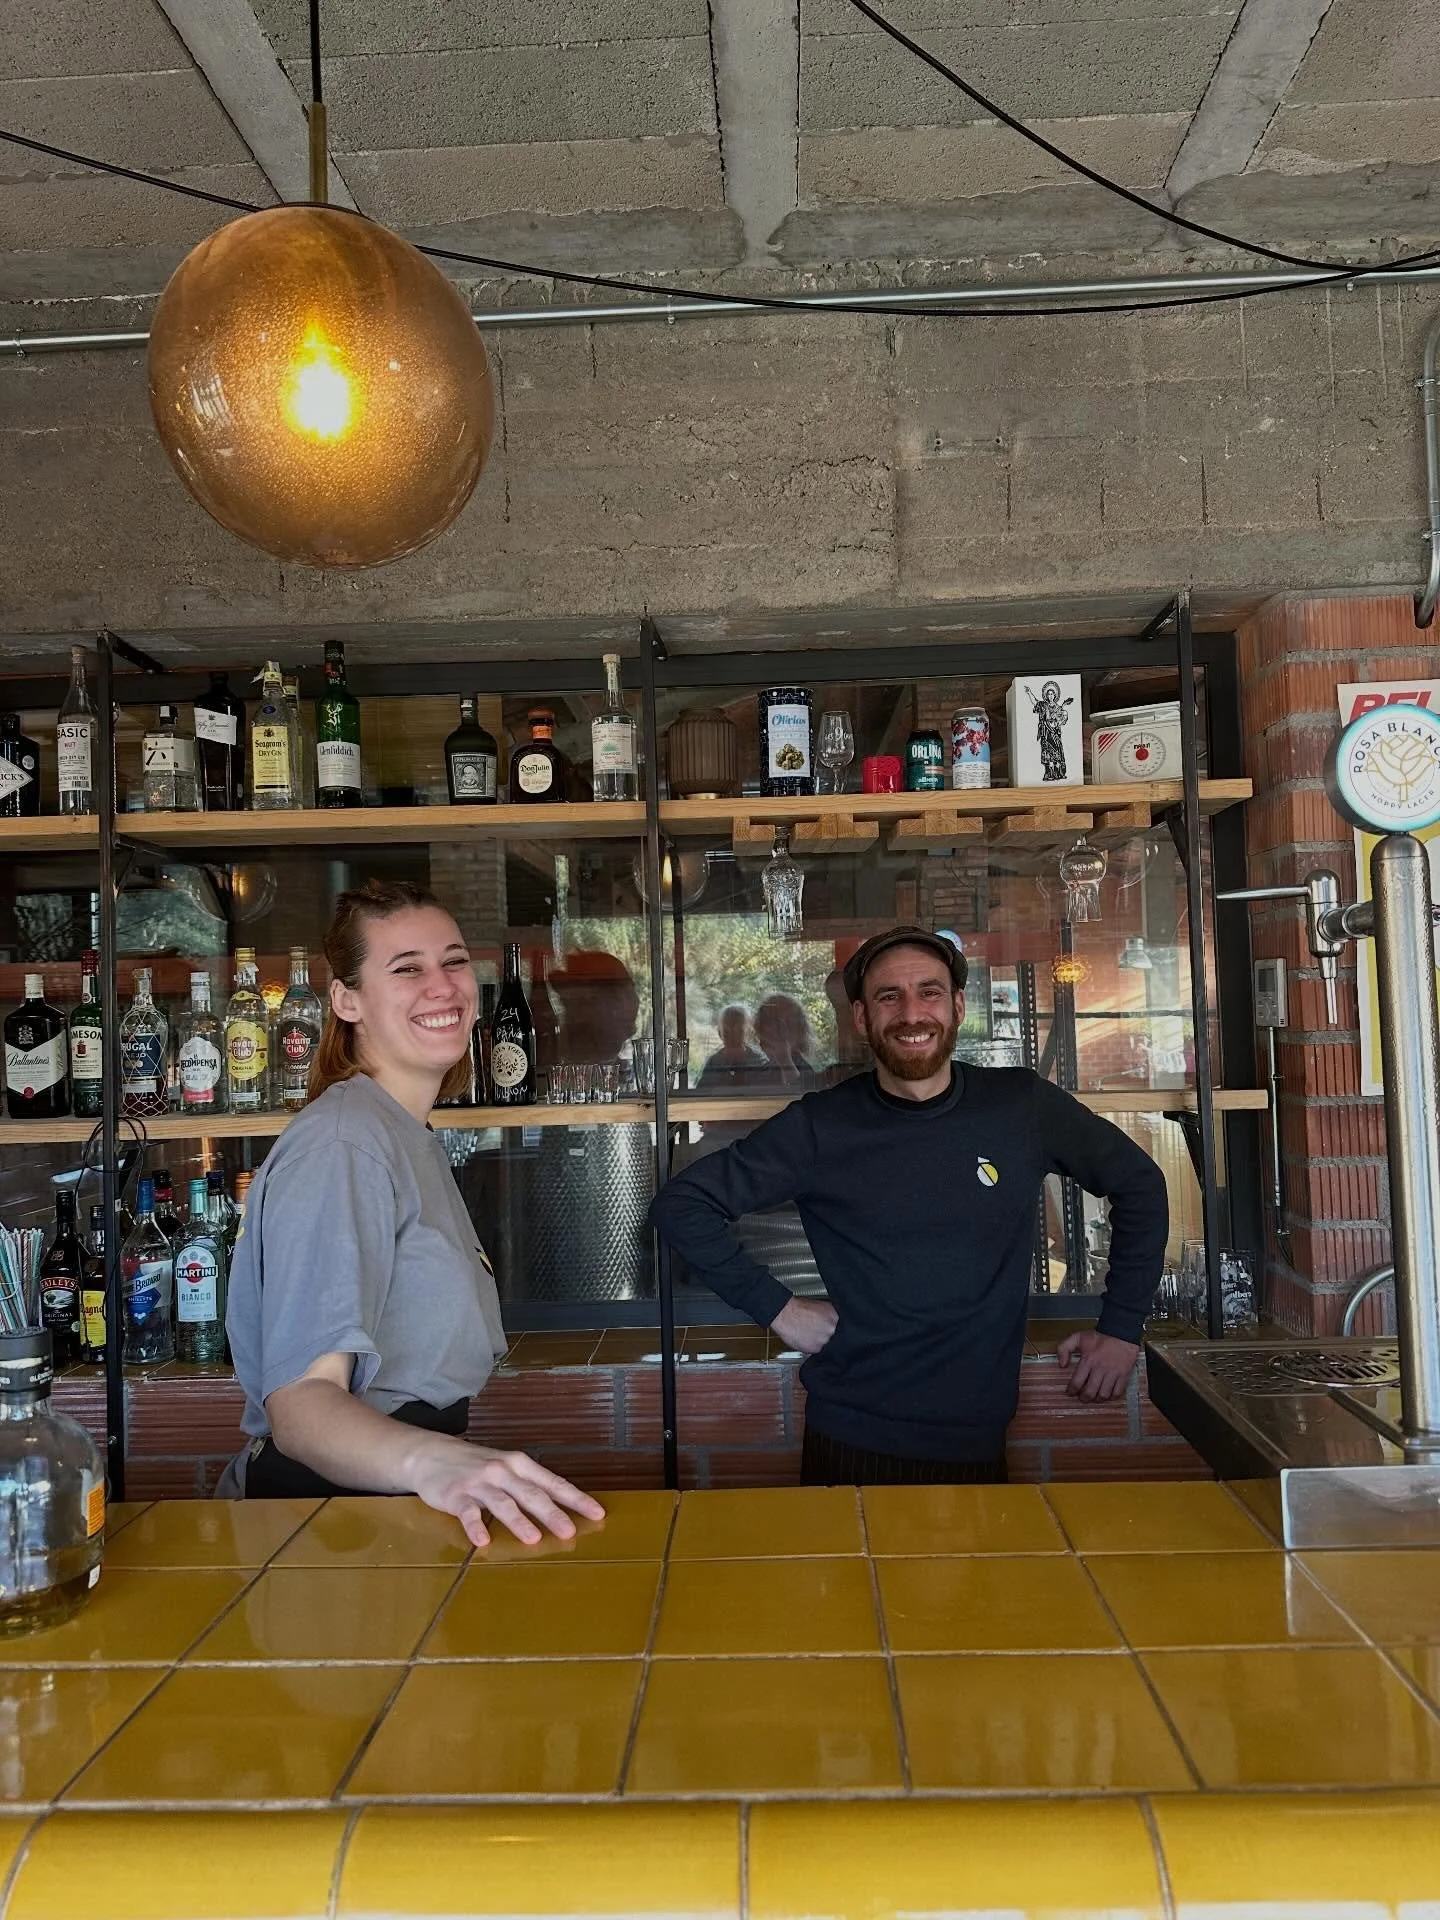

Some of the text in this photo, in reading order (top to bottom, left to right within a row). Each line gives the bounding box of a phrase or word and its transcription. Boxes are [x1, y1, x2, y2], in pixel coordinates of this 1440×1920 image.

[254, 740, 286, 749] Seagram's
[1353, 722, 1440, 773] ROSA BLANC
[911, 743, 942, 760] ORLINA
[500, 1007, 520, 1023] 24
[70, 1030, 103, 1041] MESON
[282, 1037, 311, 1046] Havana
[233, 1048, 252, 1058] Club
[286, 1045, 305, 1054] Club
[177, 1267, 216, 1278] MARTINI
[181, 1292, 212, 1301] BIANCO
